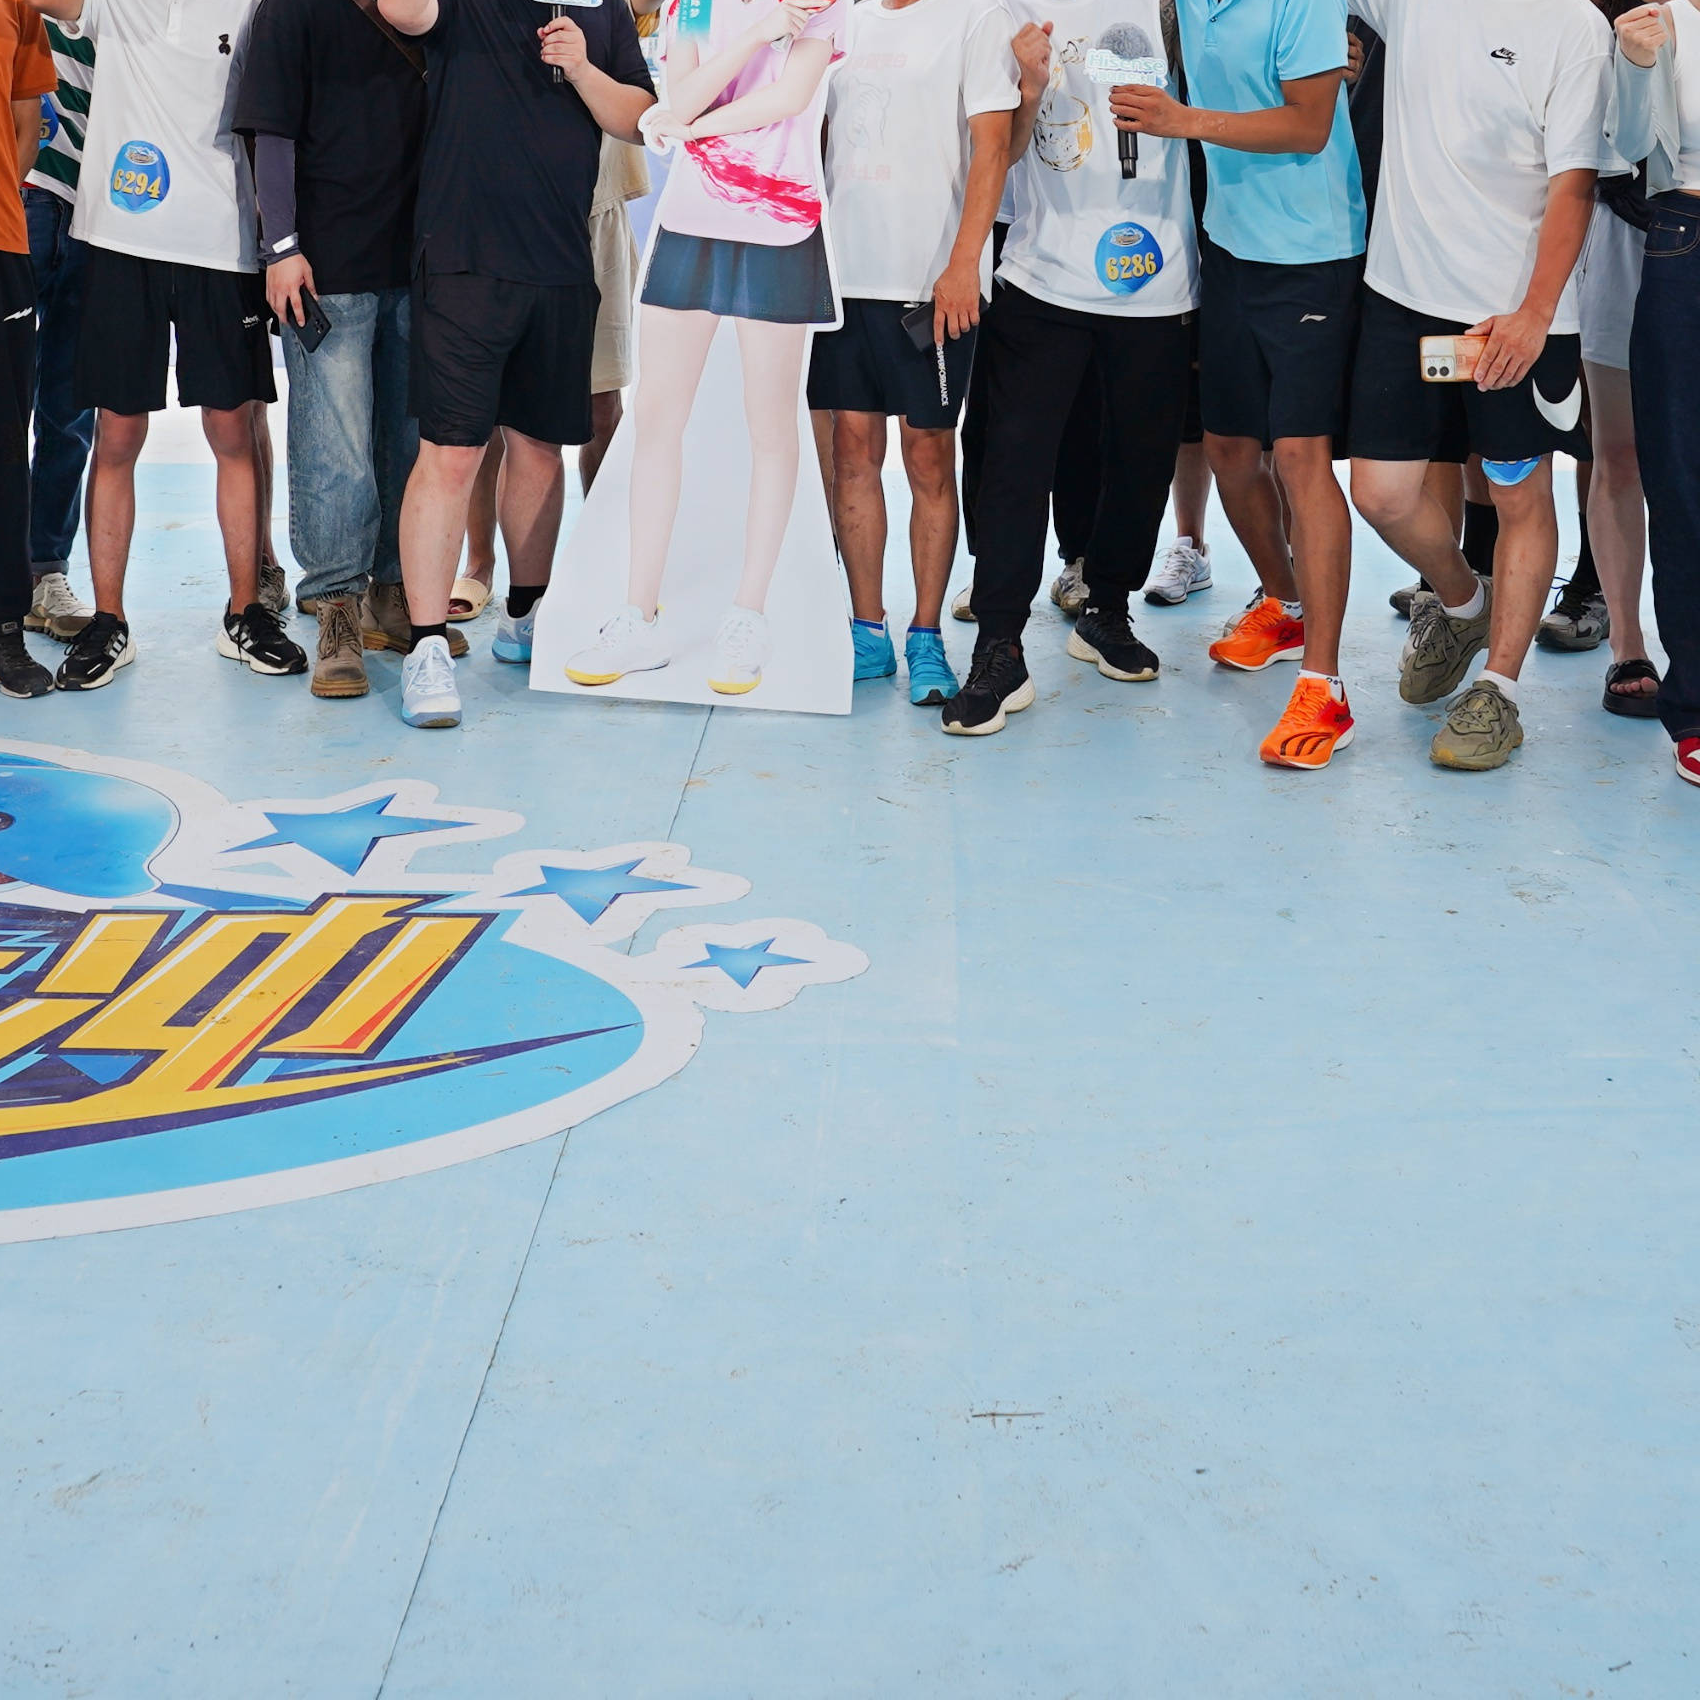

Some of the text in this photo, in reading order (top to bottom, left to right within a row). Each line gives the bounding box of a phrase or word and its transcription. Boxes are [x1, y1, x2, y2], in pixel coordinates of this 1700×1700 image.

[1089, 51, 1167, 72] Hisense
[112, 168, 163, 200] 6294
[1106, 251, 1158, 282] 6286
